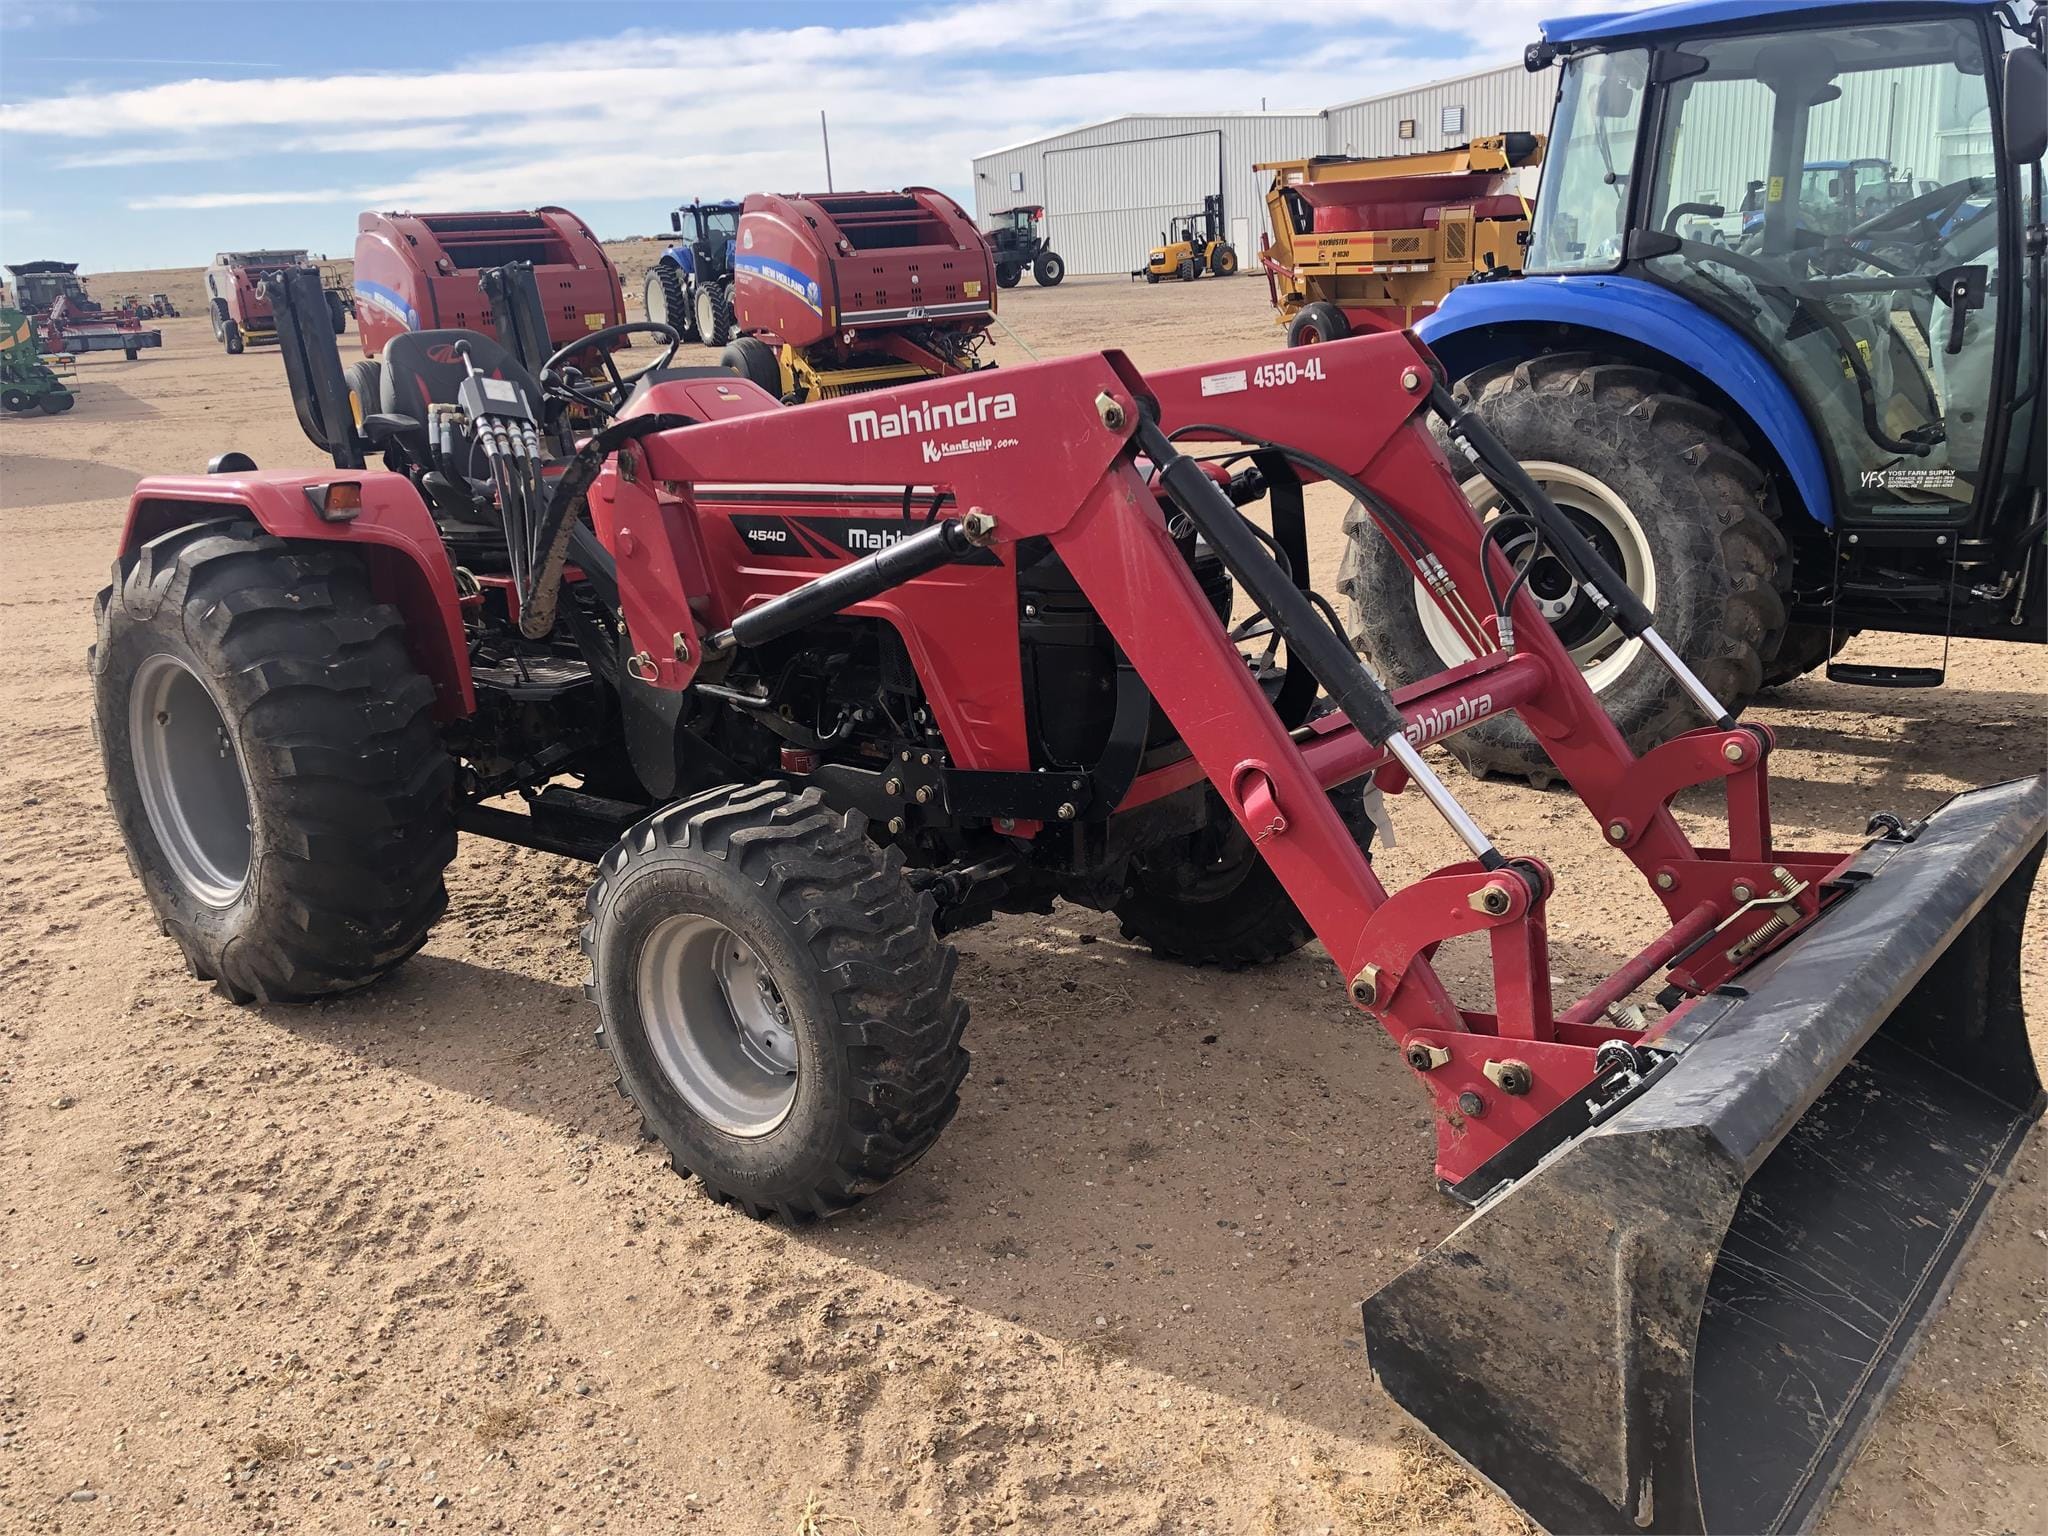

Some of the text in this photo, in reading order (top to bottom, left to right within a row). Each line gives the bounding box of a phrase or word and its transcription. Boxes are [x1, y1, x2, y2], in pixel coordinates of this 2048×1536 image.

[762, 264, 776, 279] NEW
[776, 270, 805, 296] HOLLAND
[1253, 357, 1327, 388] 4550-4L
[847, 391, 1017, 443] Mahindra
[1860, 470, 1887, 489] YFS
[748, 529, 787, 542] 4540
[848, 528, 913, 550] Mahi
[1400, 693, 1492, 747] ahindra
